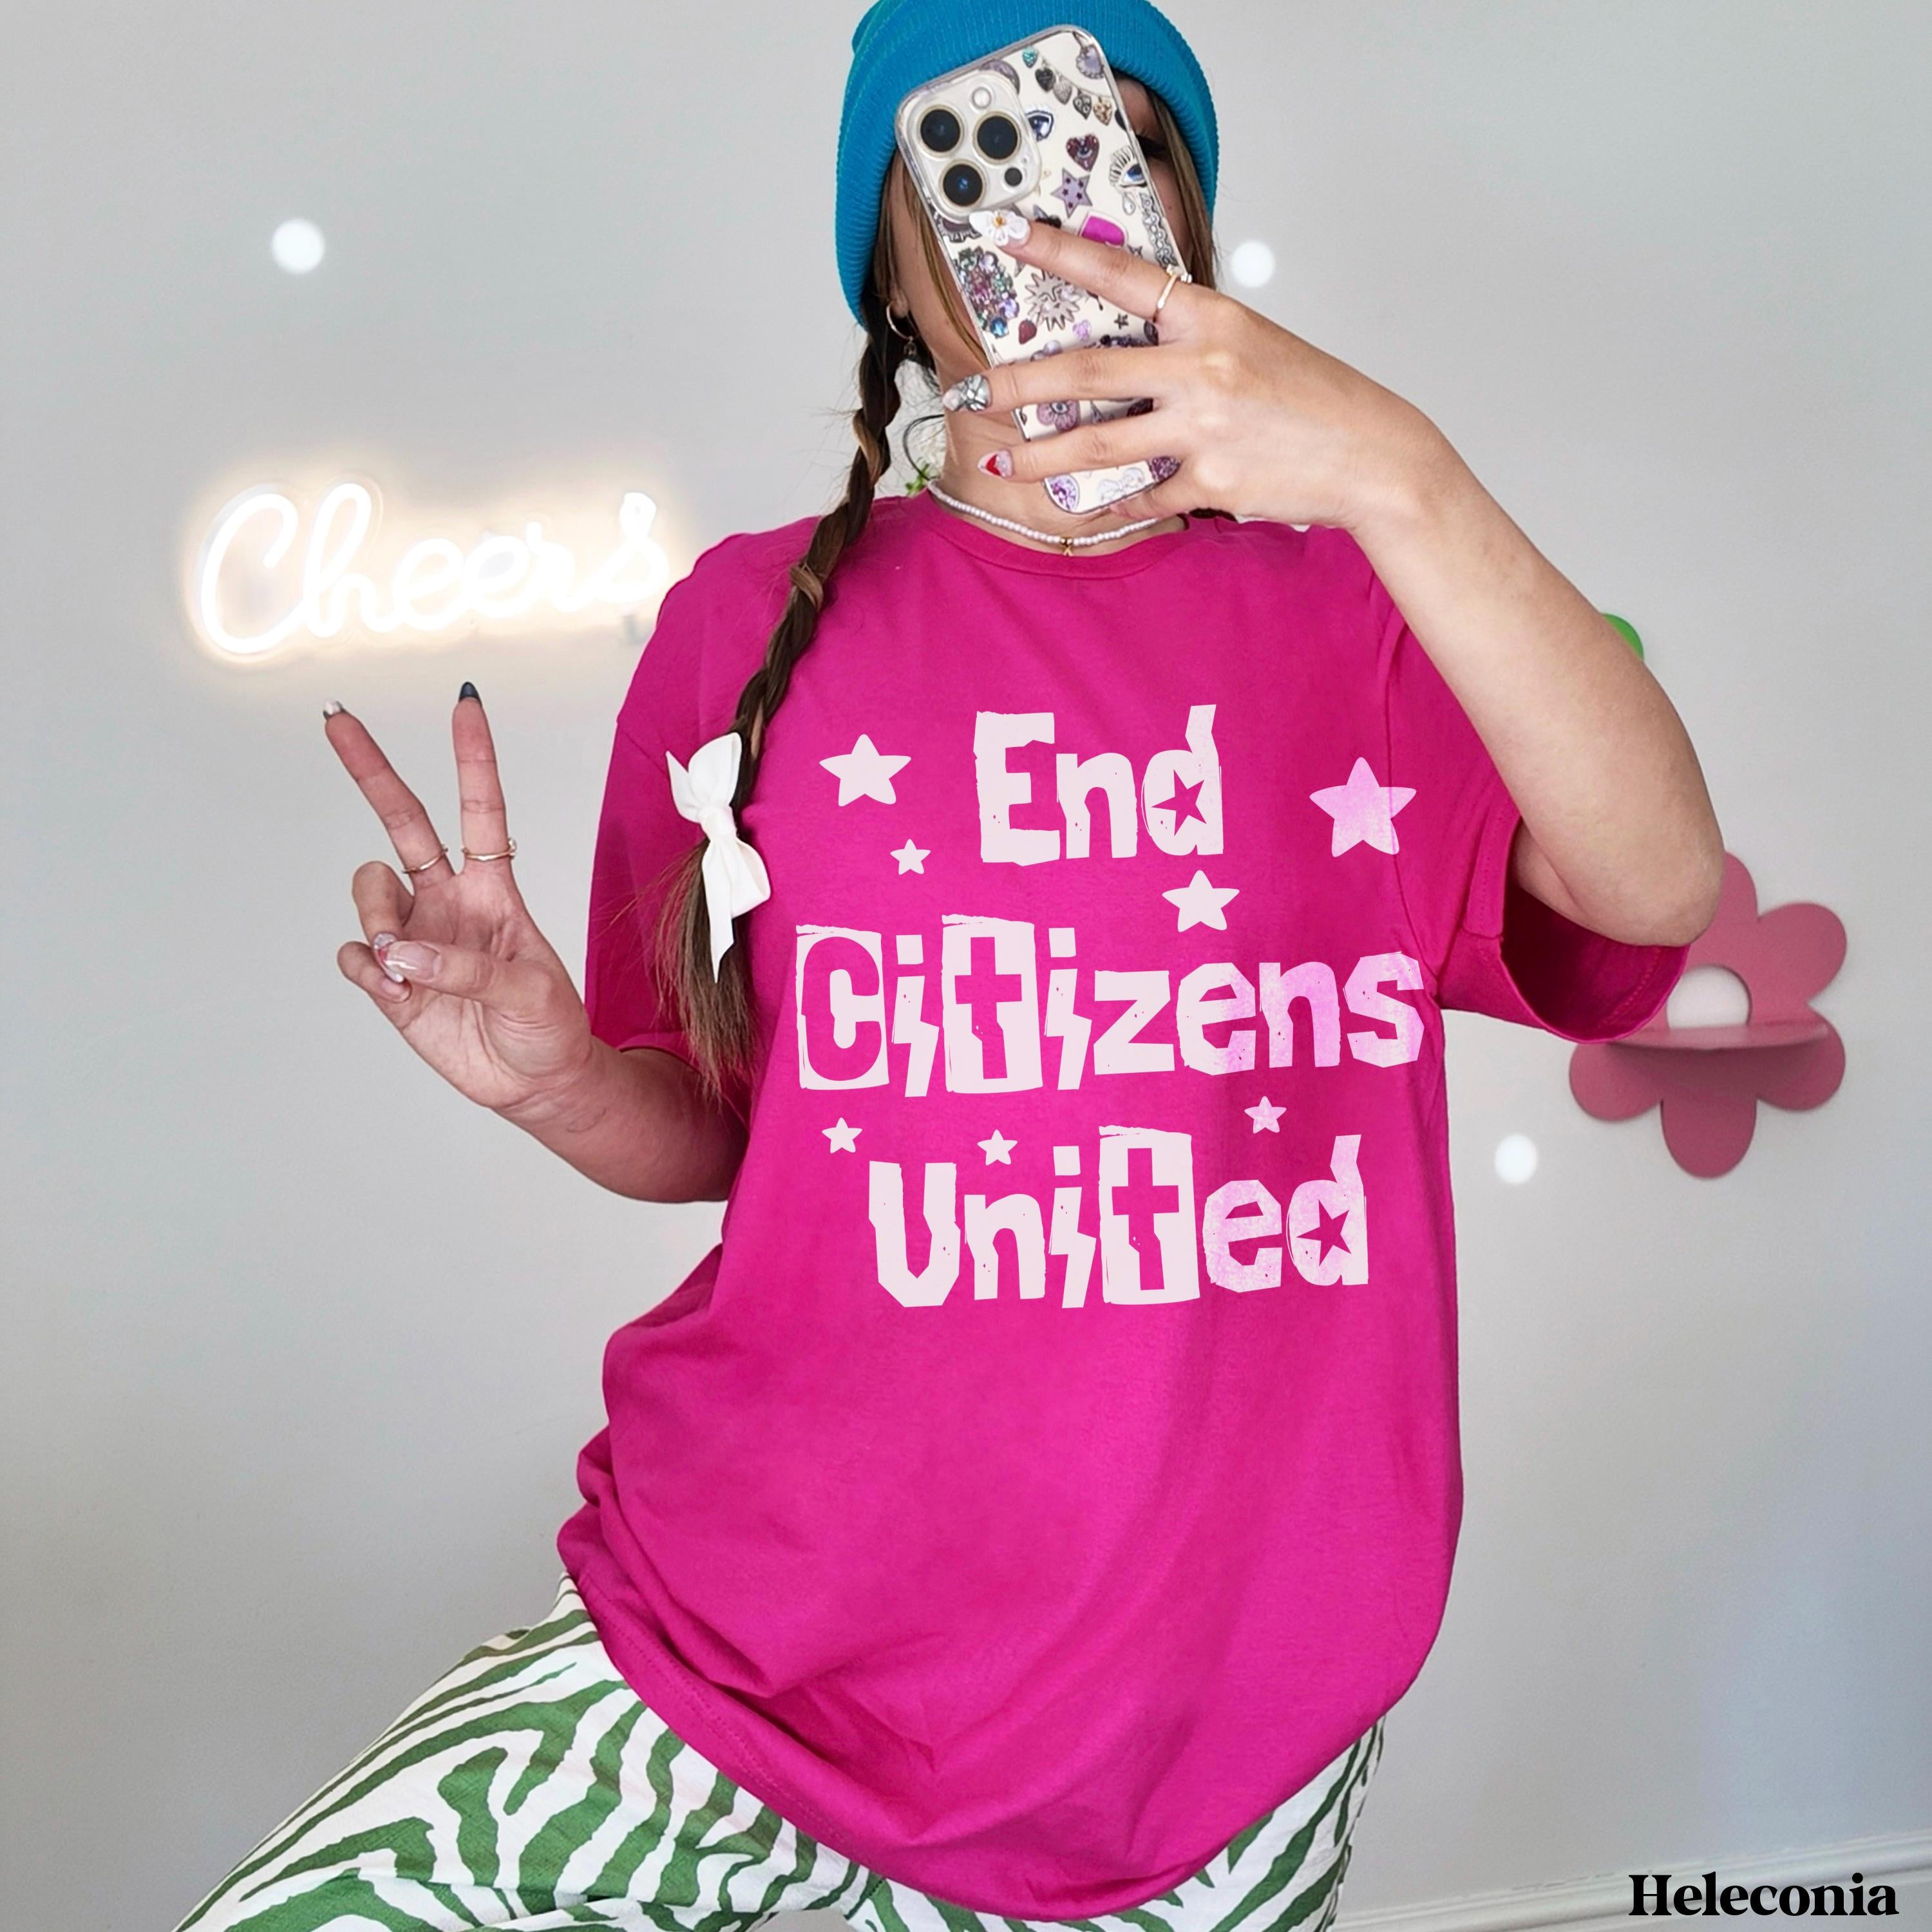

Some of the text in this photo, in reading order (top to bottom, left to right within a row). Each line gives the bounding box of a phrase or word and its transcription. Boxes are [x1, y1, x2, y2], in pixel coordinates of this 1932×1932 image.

[200, 482, 670, 655] Cheers
[973, 704, 1224, 867] End
[795, 914, 1425, 1097] Citizens
[868, 1124, 1369, 1309] United
